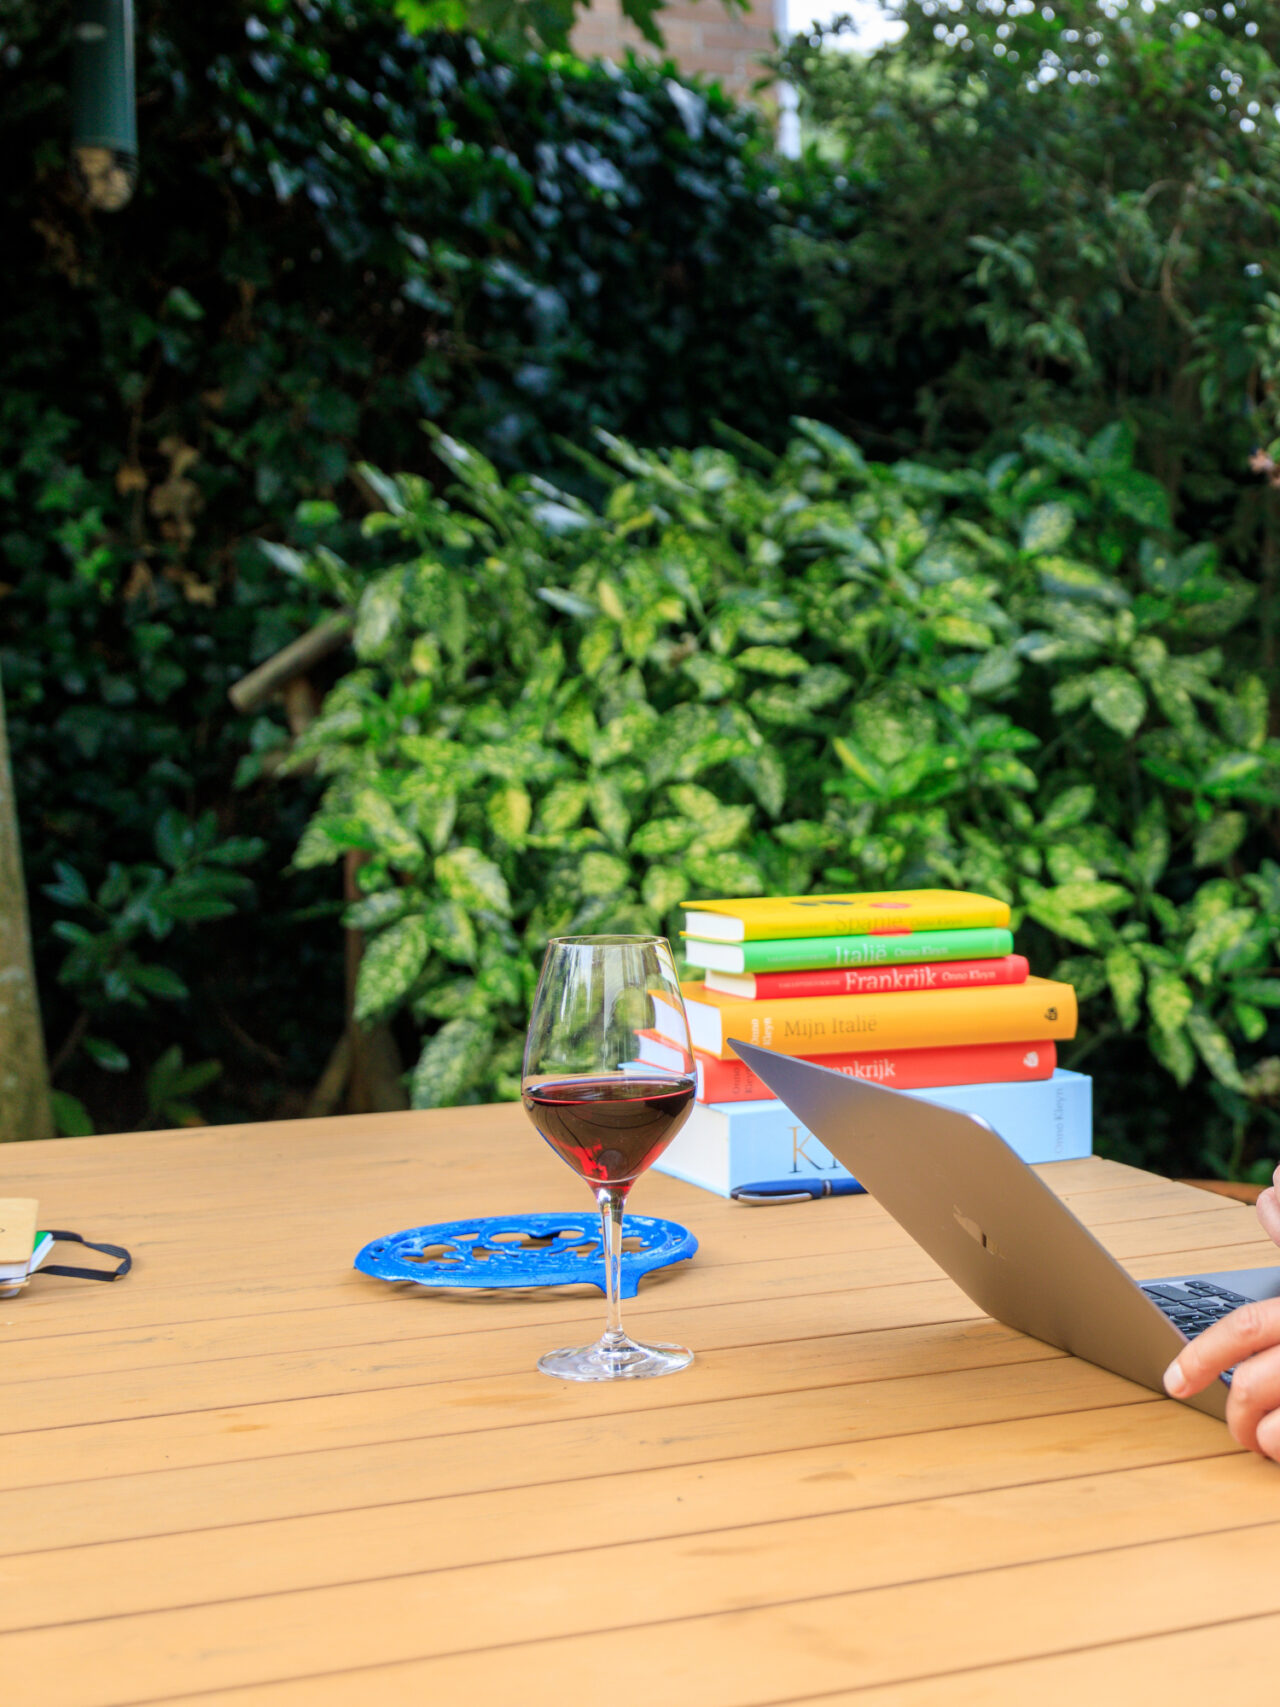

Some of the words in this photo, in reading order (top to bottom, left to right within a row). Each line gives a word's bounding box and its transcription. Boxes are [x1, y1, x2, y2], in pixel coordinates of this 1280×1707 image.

[834, 912, 904, 934] Spanje
[834, 943, 888, 966] Italië
[894, 947, 920, 958] Onno
[921, 945, 949, 957] Kleyn
[845, 966, 938, 992] Frankrijk
[942, 971, 968, 982] Onno
[968, 969, 997, 981] Kleyn
[751, 1017, 760, 1046] Onno
[762, 1016, 775, 1046] Kleyn
[784, 1019, 826, 1038] Mijn
[831, 1013, 878, 1035] Italië
[731, 1066, 741, 1094] Onno
[1053, 1087, 1067, 1121] Kleyn
[1054, 1122, 1064, 1154] Onno
